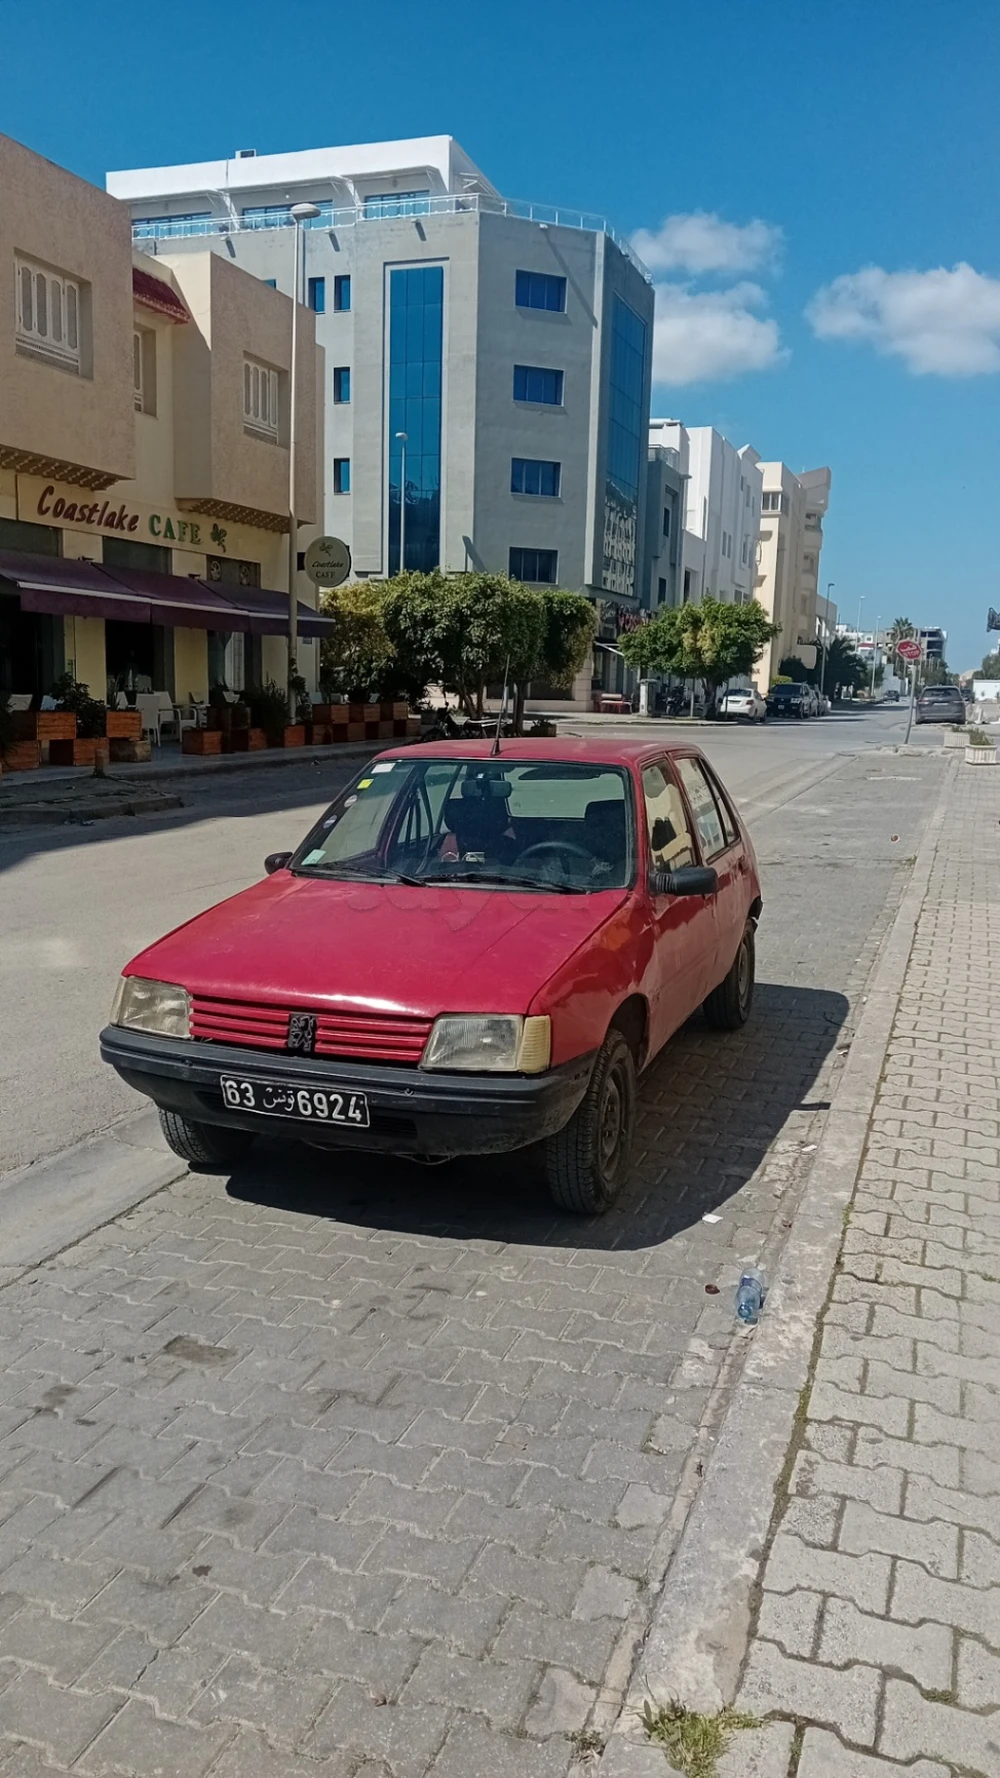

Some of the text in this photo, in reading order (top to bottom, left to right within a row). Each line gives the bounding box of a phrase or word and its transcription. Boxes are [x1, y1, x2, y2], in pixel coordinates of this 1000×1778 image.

[37, 485, 201, 545] Coastlake CAFE
[225, 1080, 362, 1122] 63 تونس 6924
